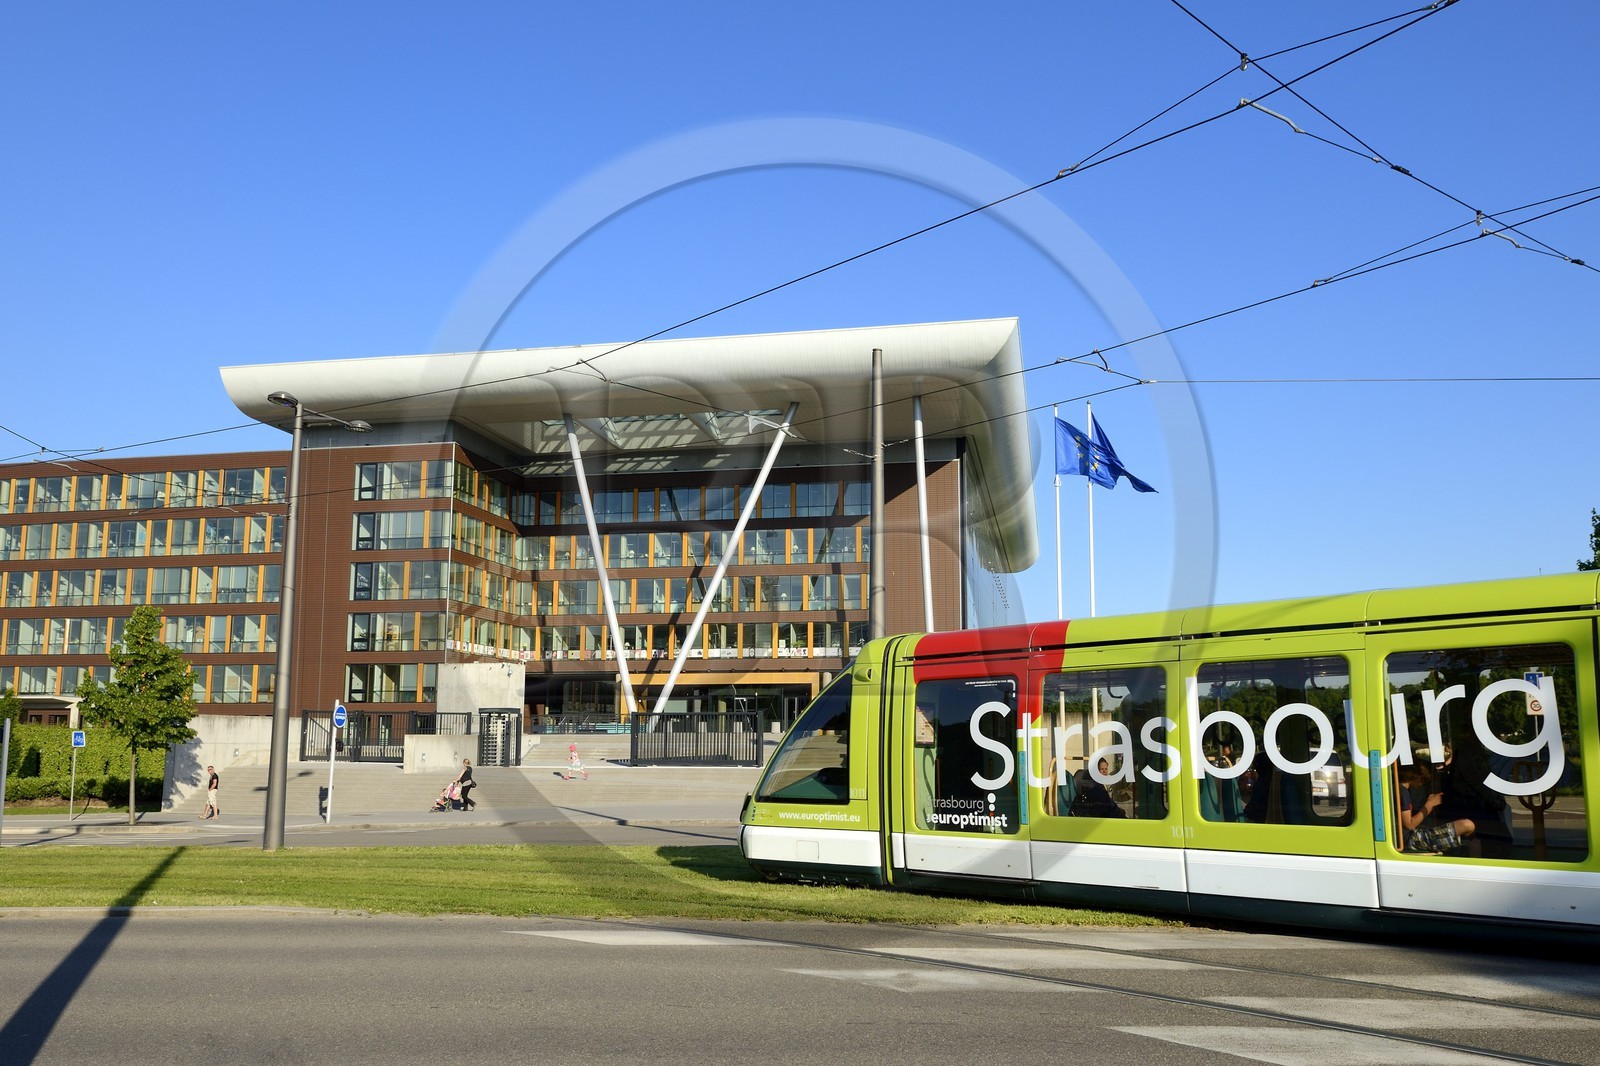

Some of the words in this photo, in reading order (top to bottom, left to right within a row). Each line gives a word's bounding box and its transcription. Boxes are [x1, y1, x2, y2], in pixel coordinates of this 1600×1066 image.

[970, 676, 1565, 796] Strasbourg
[779, 811, 861, 822] www.europtimist.eu
[931, 811, 1008, 829] europtimist
